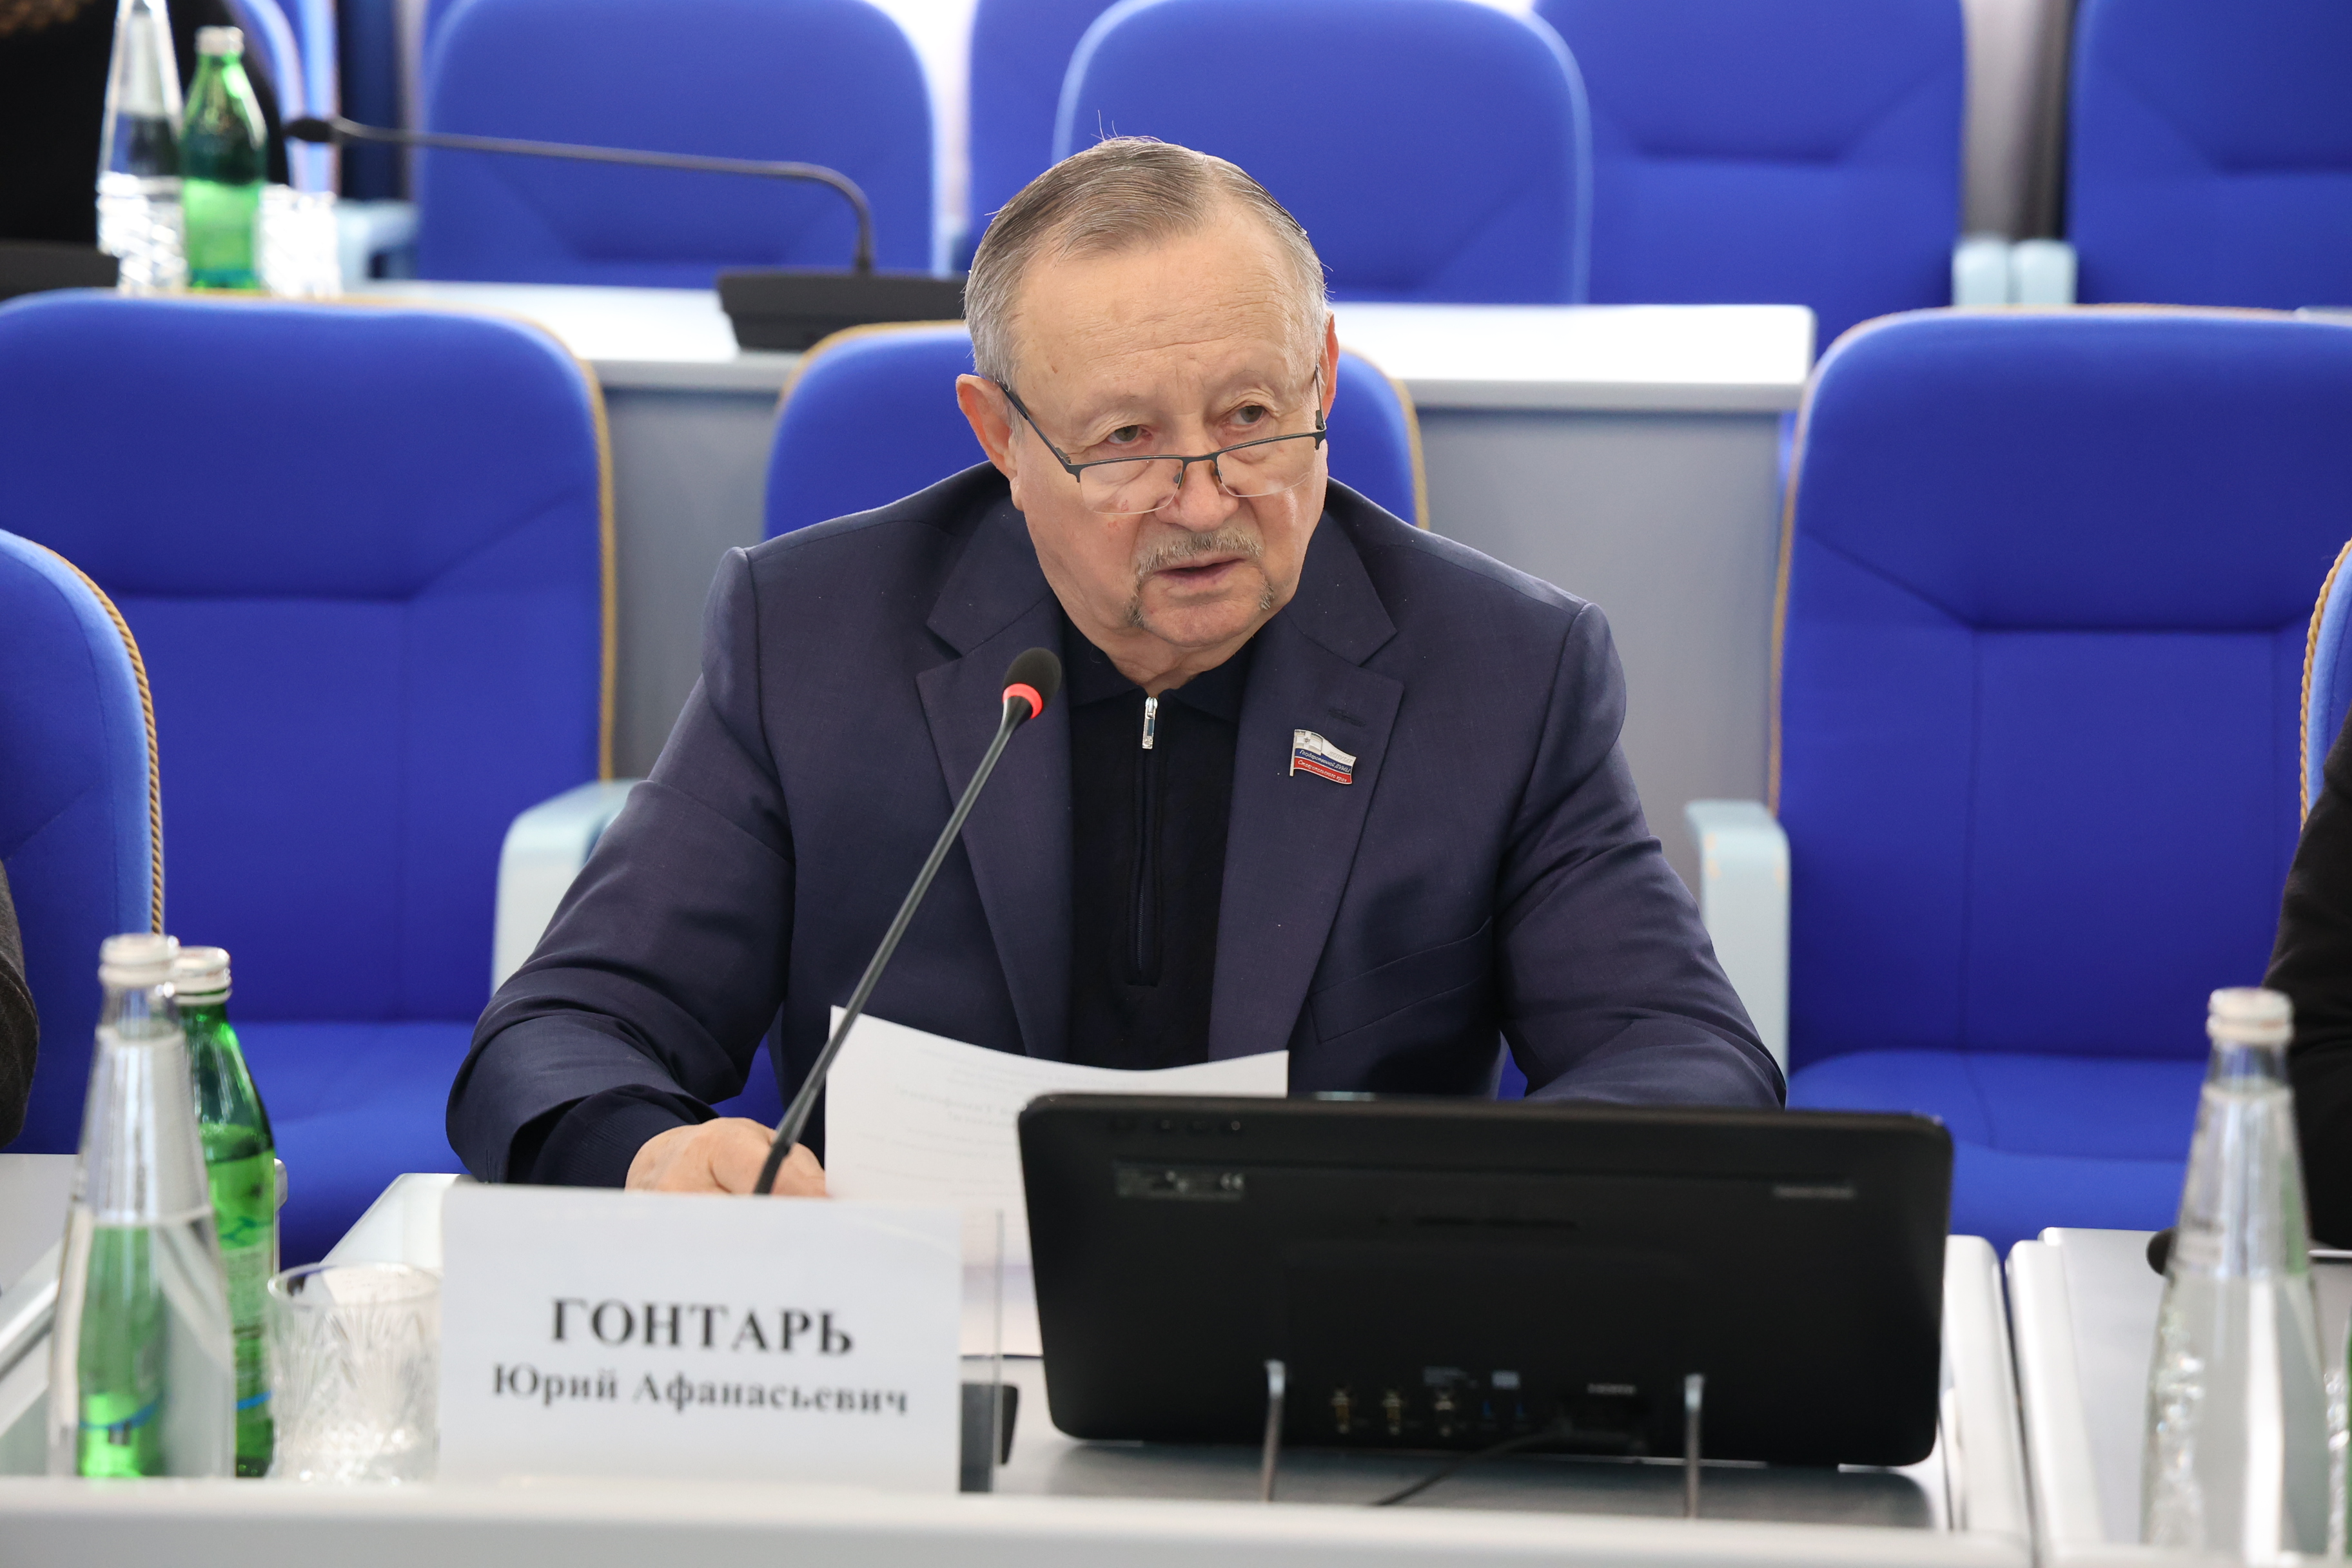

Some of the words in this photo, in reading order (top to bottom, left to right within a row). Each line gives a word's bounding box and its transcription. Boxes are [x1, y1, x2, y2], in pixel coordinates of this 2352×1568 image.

[551, 1298, 855, 1356] ГОНТАРЬ
[492, 1363, 619, 1408] Юрий
[634, 1371, 908, 1415] Афанасьевич
